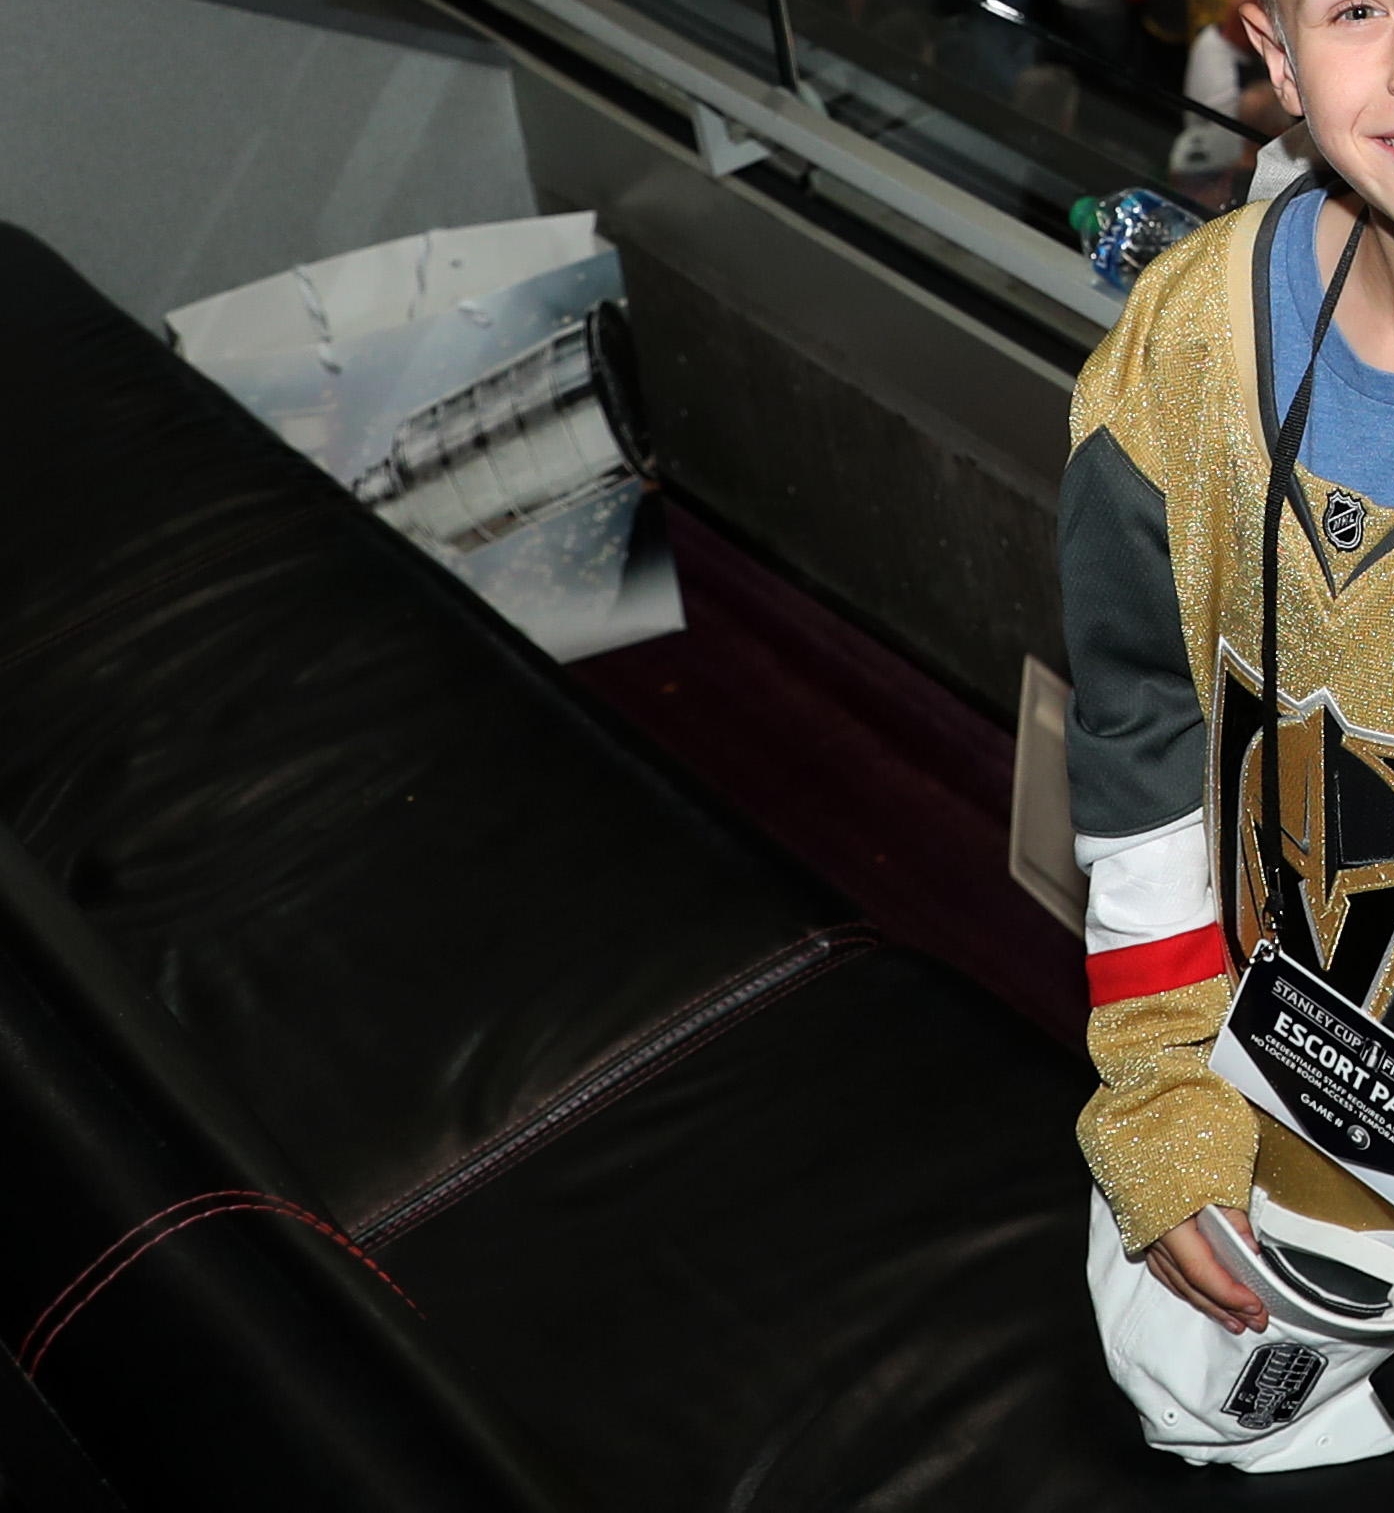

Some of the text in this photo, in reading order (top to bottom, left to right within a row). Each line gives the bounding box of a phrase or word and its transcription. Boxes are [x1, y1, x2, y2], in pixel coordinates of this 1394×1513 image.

[1332, 513, 1355, 531] NHL
[1272, 980, 1334, 1028] STANLEY
[1333, 1024, 1362, 1047] CUP
[1250, 1034, 1266, 1049] NO
[1264, 1043, 1297, 1070] LOCKER
[1296, 1066, 1323, 1090] ROOM
[1322, 1086, 1354, 1112] ACCESS
[1264, 1034, 1323, 1079] CREDENTIALED
[1322, 1075, 1348, 1095] STAFF
[1346, 1092, 1386, 1125] REQUIRED
[1273, 1010, 1371, 1091] ESCORT
[1300, 1092, 1367, 1143] GAME # 5
